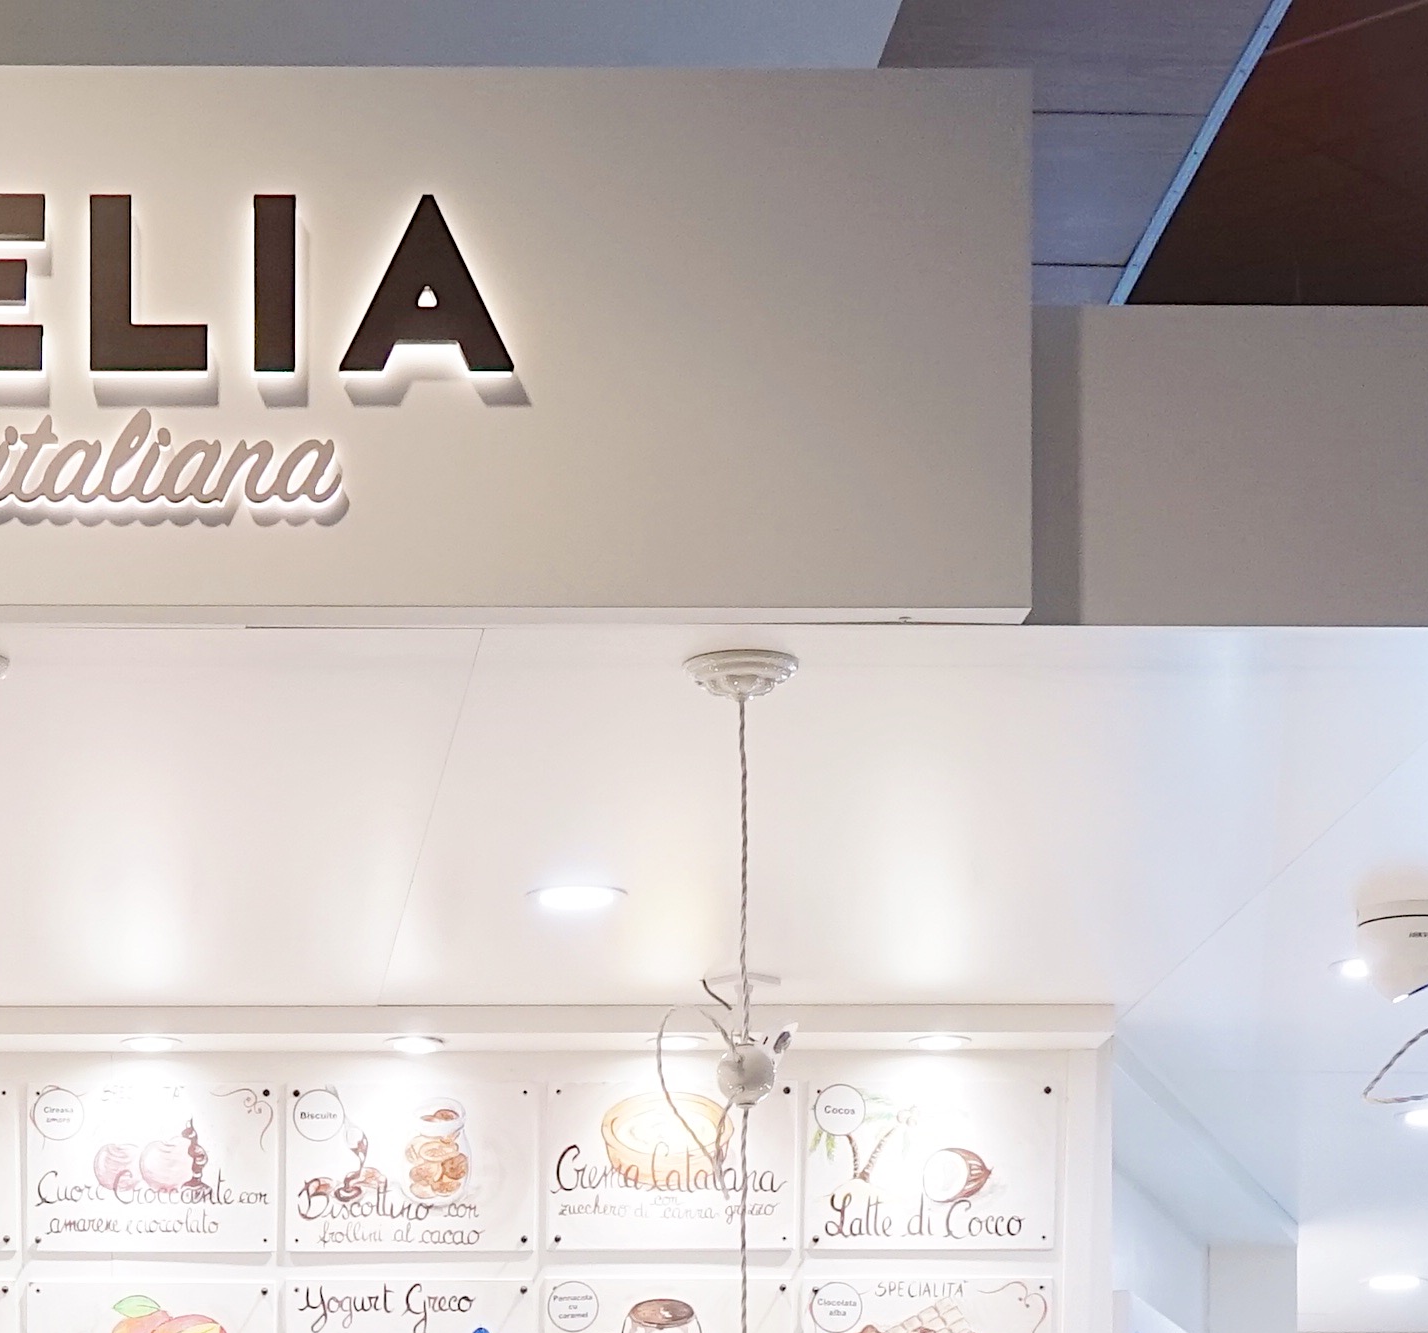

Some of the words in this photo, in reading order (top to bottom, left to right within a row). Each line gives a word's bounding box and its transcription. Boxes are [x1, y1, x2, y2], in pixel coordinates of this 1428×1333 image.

[824, 1106, 855, 1115] Cocos
[34, 1171, 105, 1207] Cuori
[113, 1168, 236, 1206] Croccante
[238, 1191, 270, 1206] con
[550, 1144, 641, 1194] Crema
[297, 1175, 434, 1221] Biscottino
[442, 1202, 479, 1219] con
[558, 1196, 629, 1217] zucchero
[825, 1193, 894, 1238] Latte
[901, 1208, 934, 1238] di
[943, 1199, 1026, 1241] Cocco
[317, 1221, 384, 1247] frollini
[390, 1223, 413, 1243] al
[419, 1229, 486, 1245] cacao
[297, 1283, 395, 1332] Yogurt
